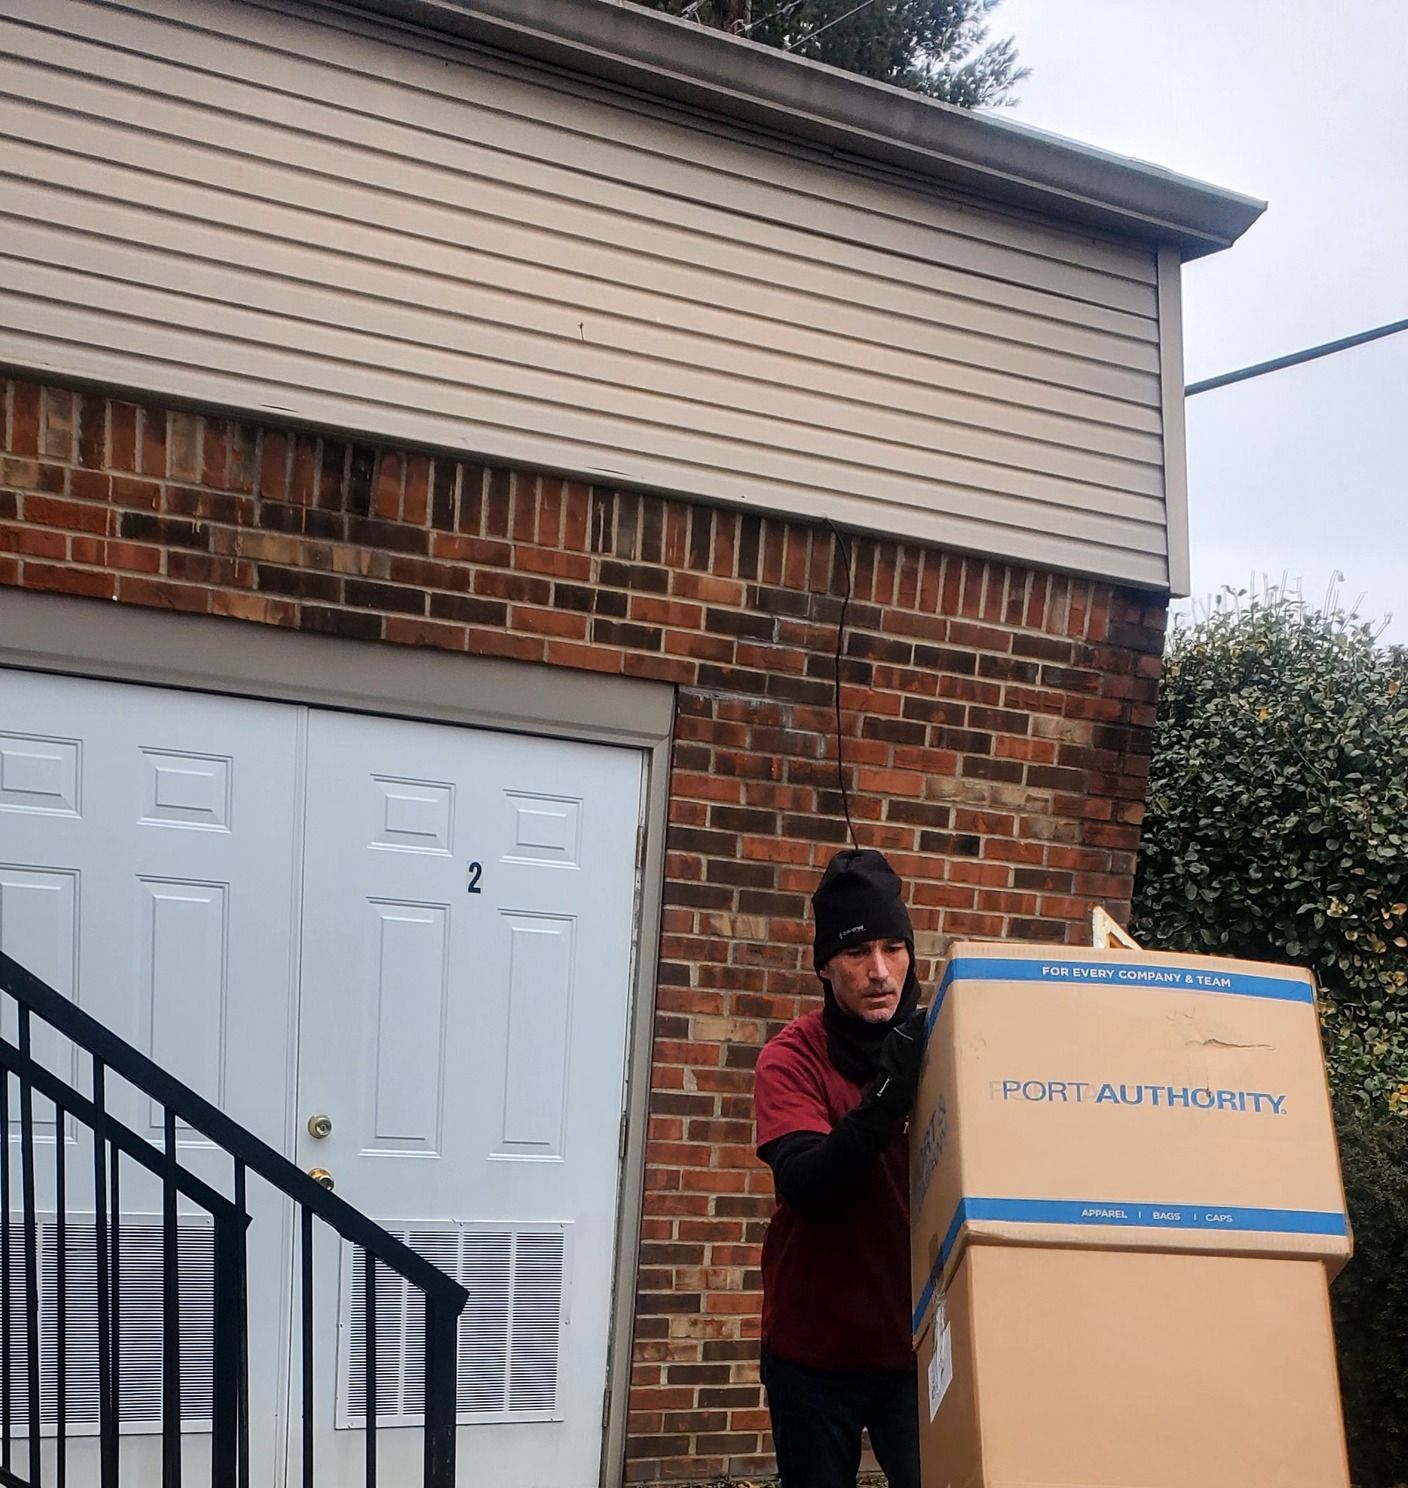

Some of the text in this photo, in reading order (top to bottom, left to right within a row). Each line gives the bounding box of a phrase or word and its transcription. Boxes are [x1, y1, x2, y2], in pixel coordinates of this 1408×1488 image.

[468, 861, 482, 894] 2
[1042, 966, 1231, 987] FOR EVERY COMPANY & TEAM
[1002, 1080, 1089, 1103] PORT
[1081, 1209, 1233, 1223] APPAREL BAGS CAPS
